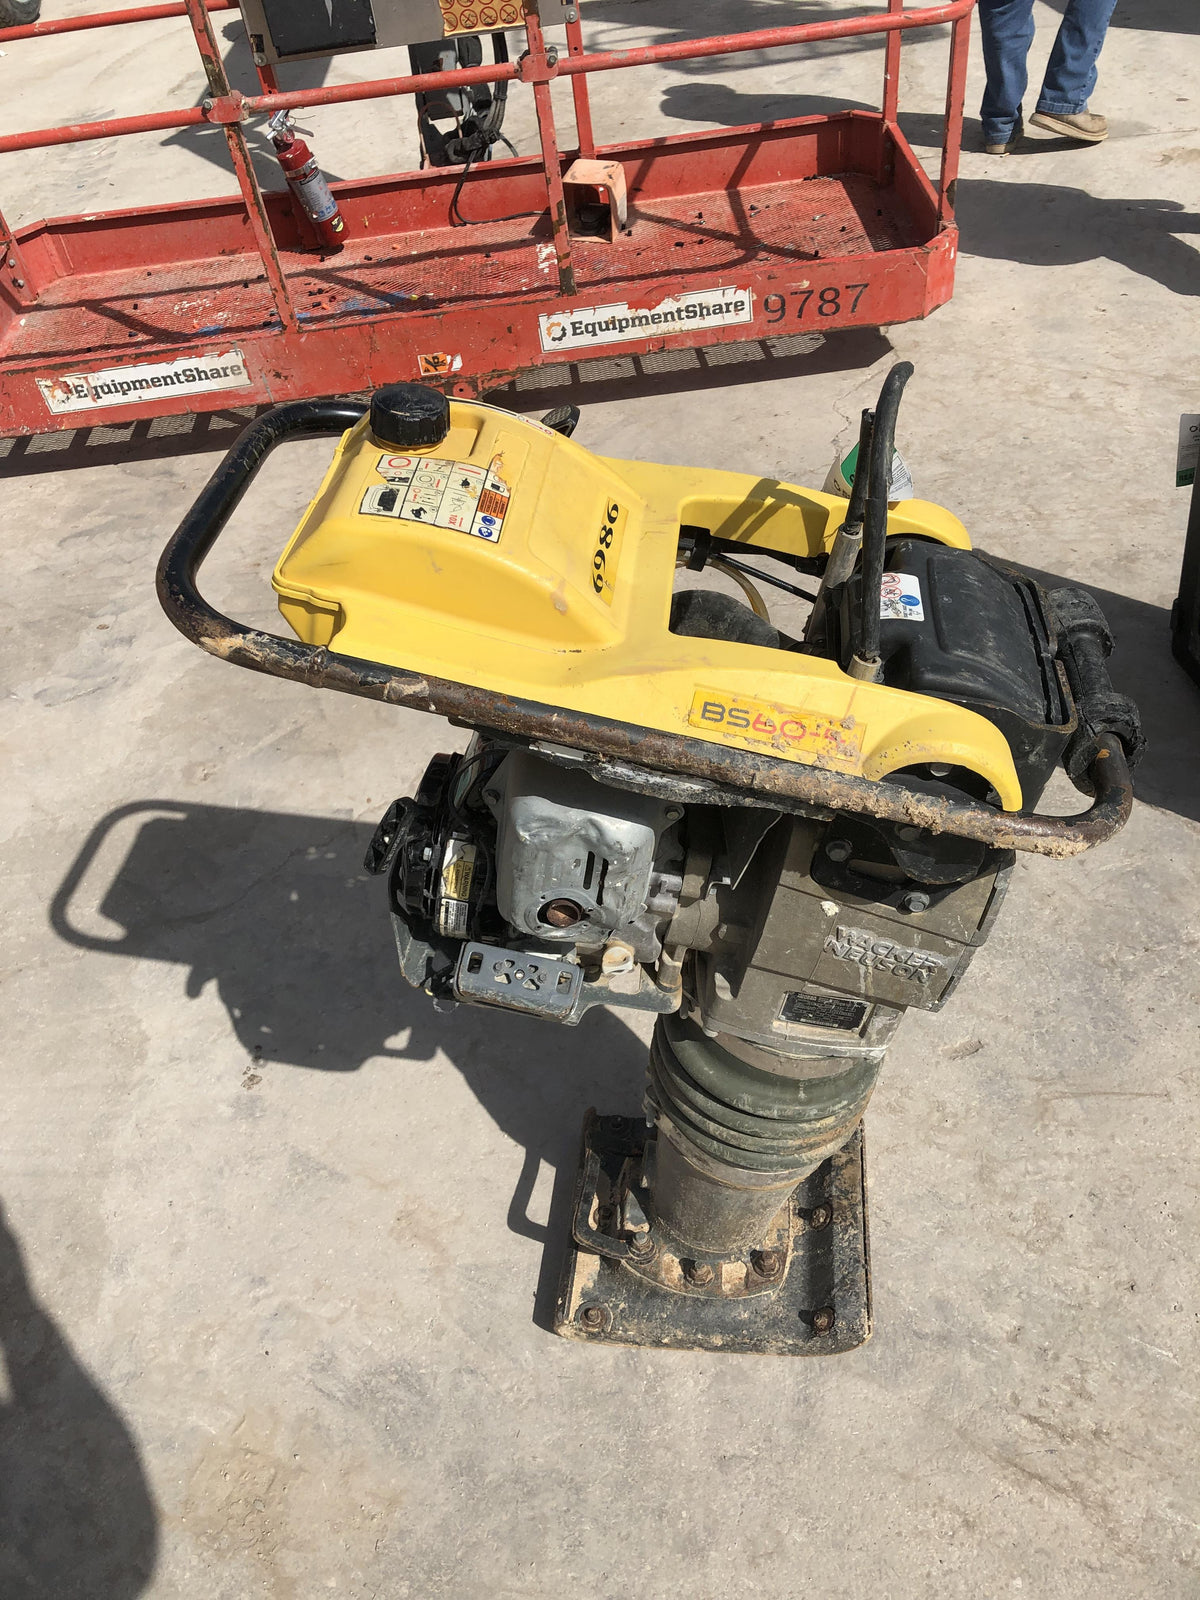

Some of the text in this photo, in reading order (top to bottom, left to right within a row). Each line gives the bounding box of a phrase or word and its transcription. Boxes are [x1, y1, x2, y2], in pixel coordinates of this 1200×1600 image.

[570, 299, 745, 338] EquipmentShare
[763, 283, 869, 323] 9787
[74, 364, 242, 402] EquipmentShare
[824, 938, 929, 984] NEUSON
